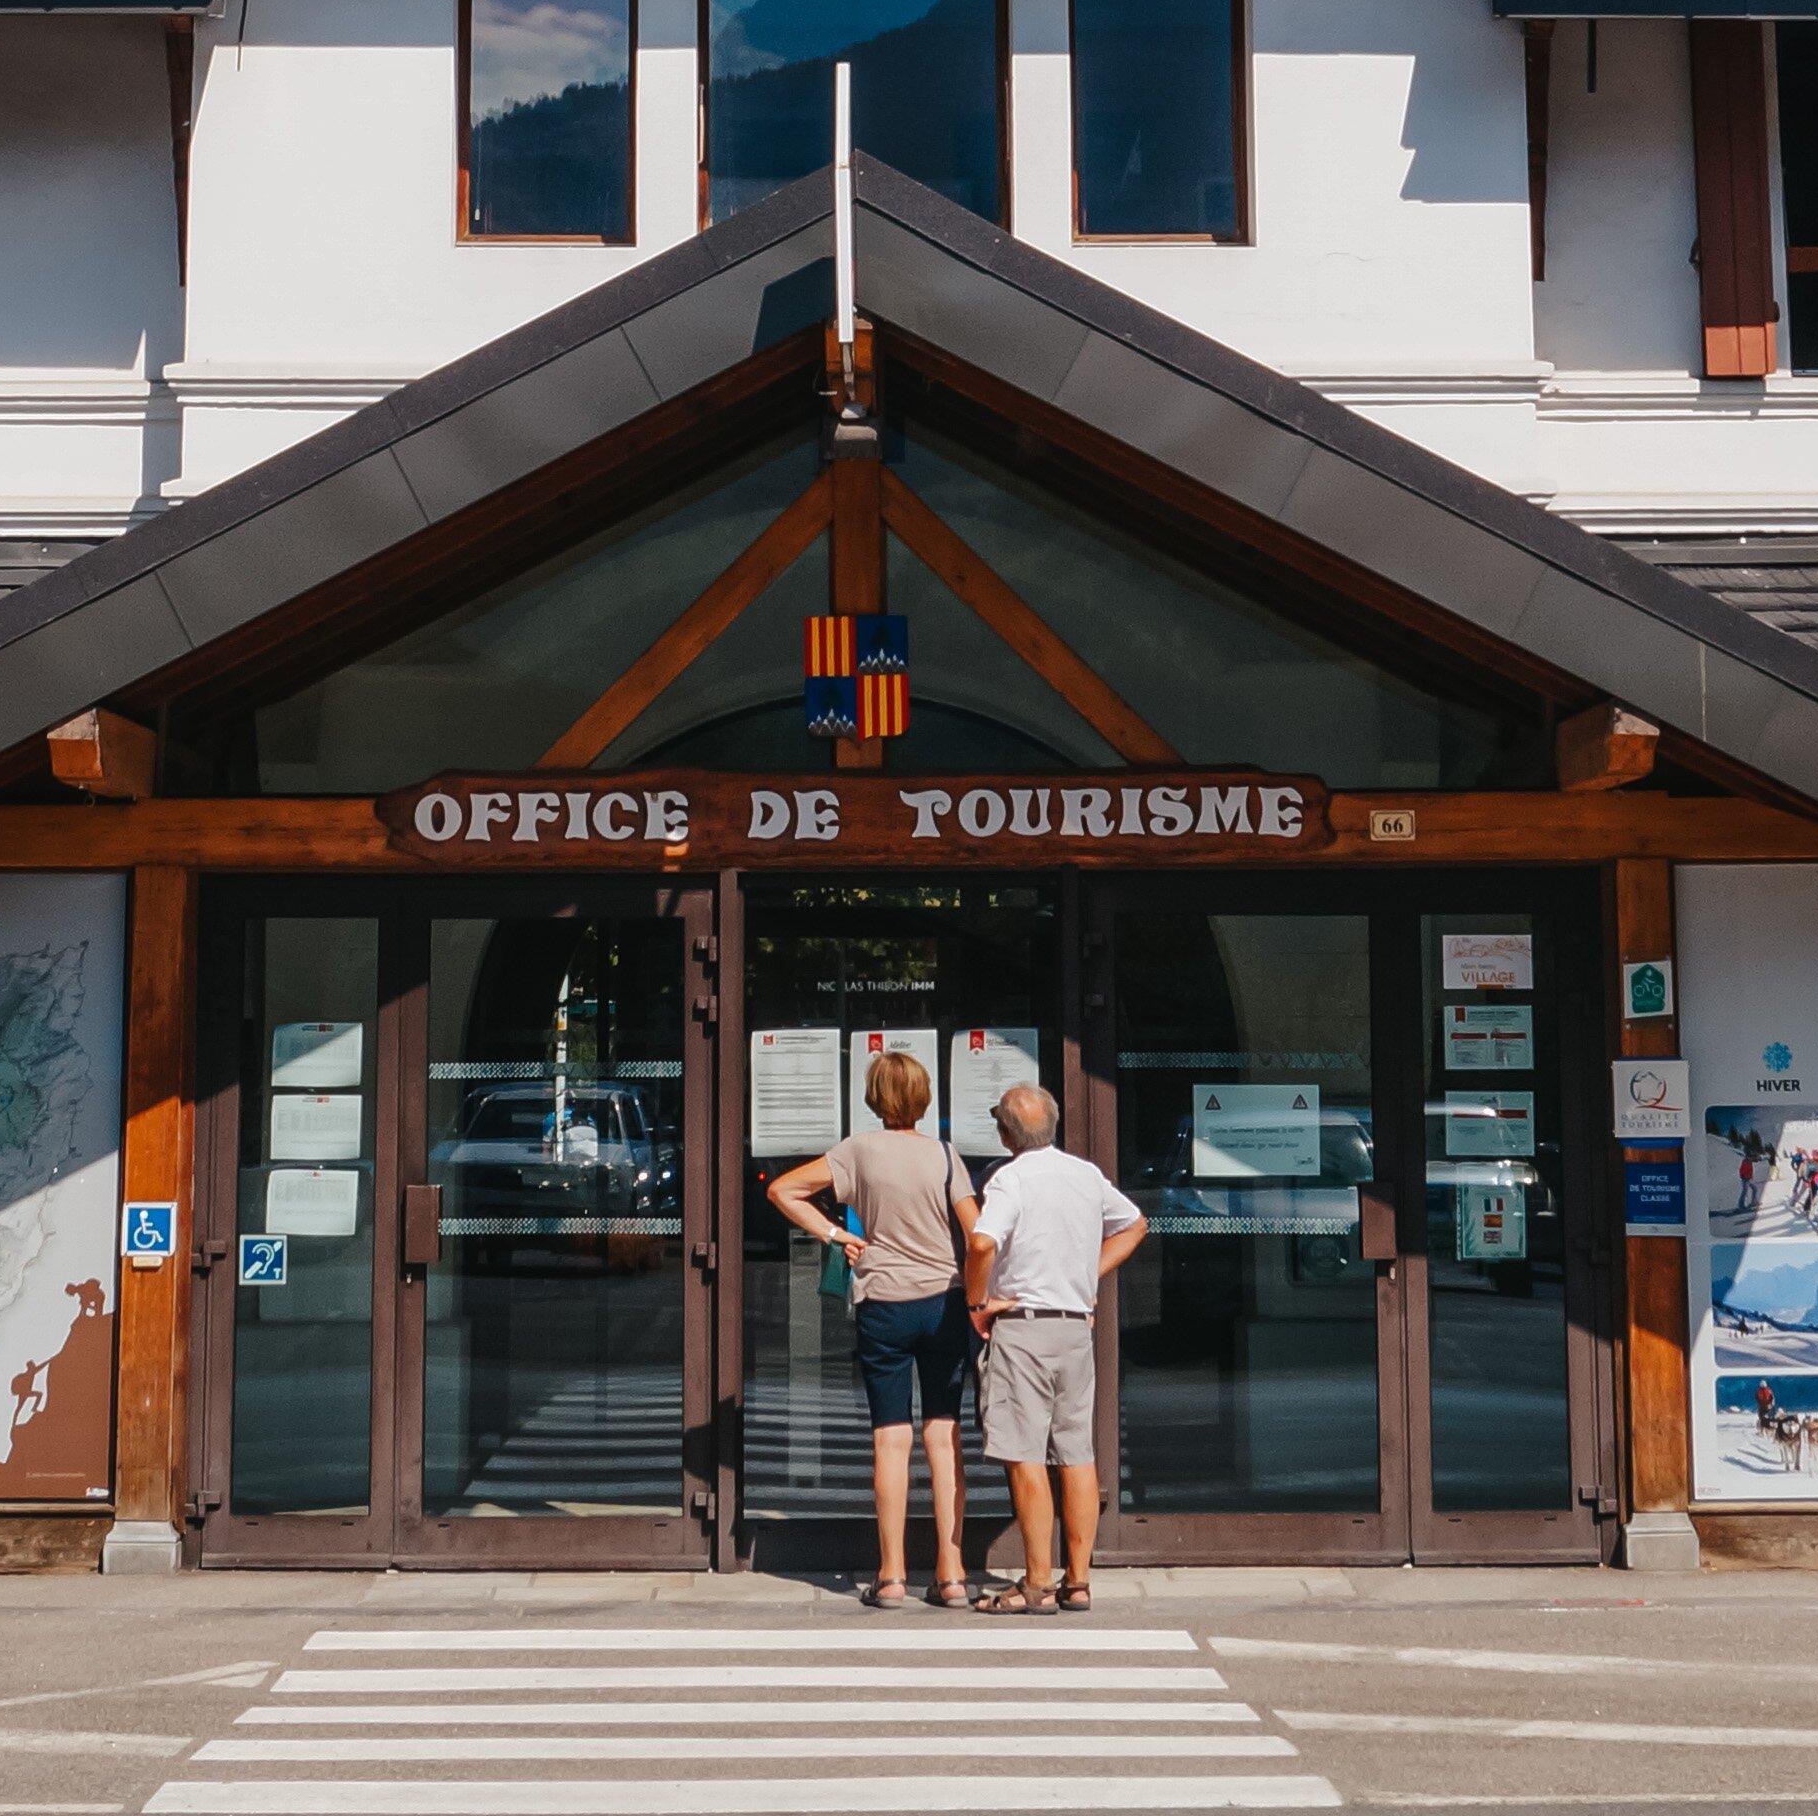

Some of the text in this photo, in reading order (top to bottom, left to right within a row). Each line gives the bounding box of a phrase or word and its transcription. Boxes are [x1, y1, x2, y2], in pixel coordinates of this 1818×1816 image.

[414, 786, 1304, 842] OFFICE DE TOURISME
[1381, 819, 1404, 834] 66
[1461, 971, 1516, 983] VILLAGE
[1756, 1080, 1801, 1092] HIVER
